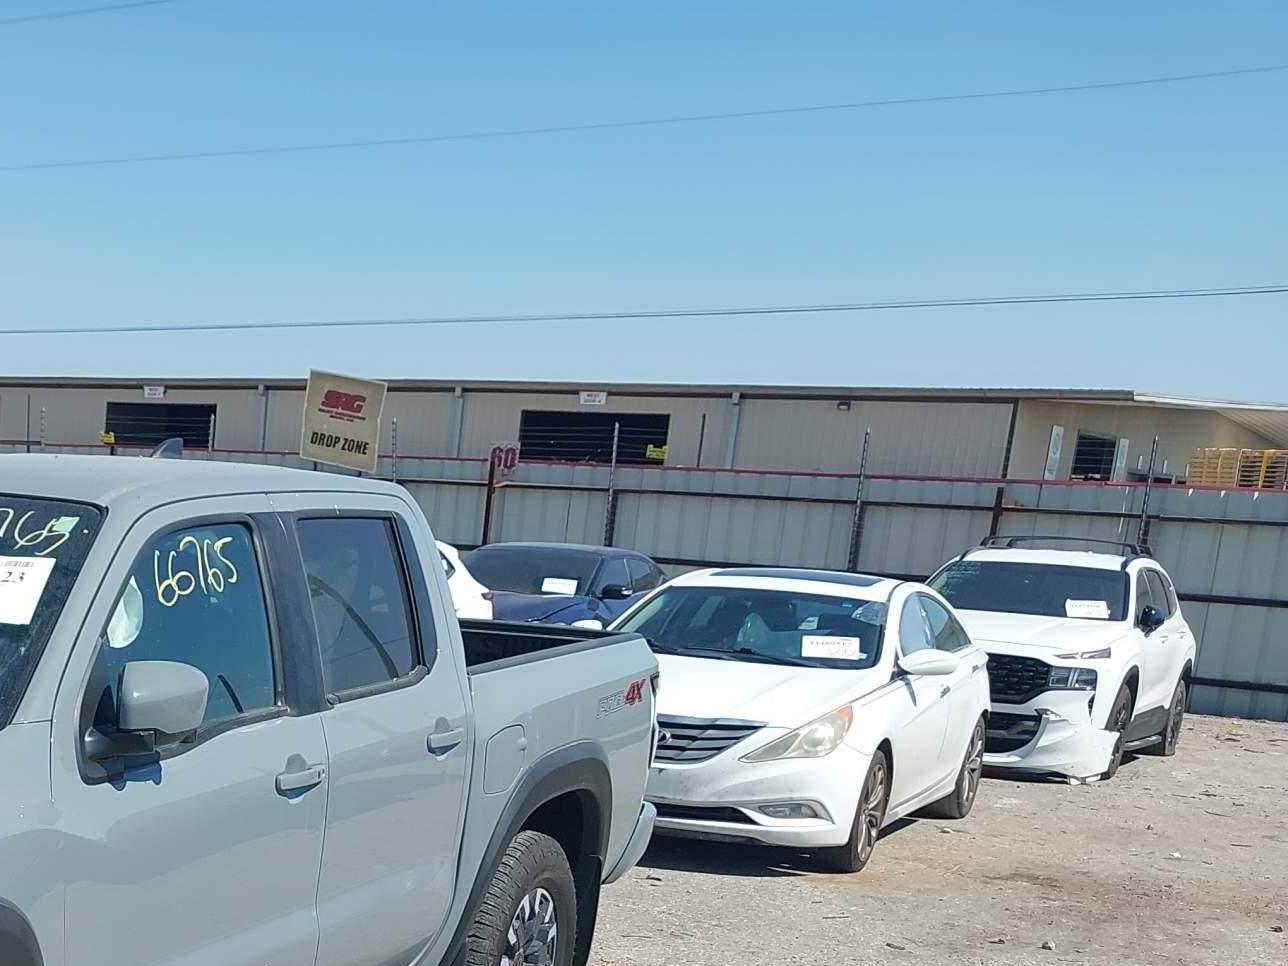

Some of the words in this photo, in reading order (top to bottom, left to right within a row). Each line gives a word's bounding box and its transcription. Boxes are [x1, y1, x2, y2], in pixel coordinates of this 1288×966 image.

[310, 431, 341, 449] DROP
[341, 437, 370, 455] ZONE
[490, 446, 517, 470] 60
[154, 536, 238, 607] 66765
